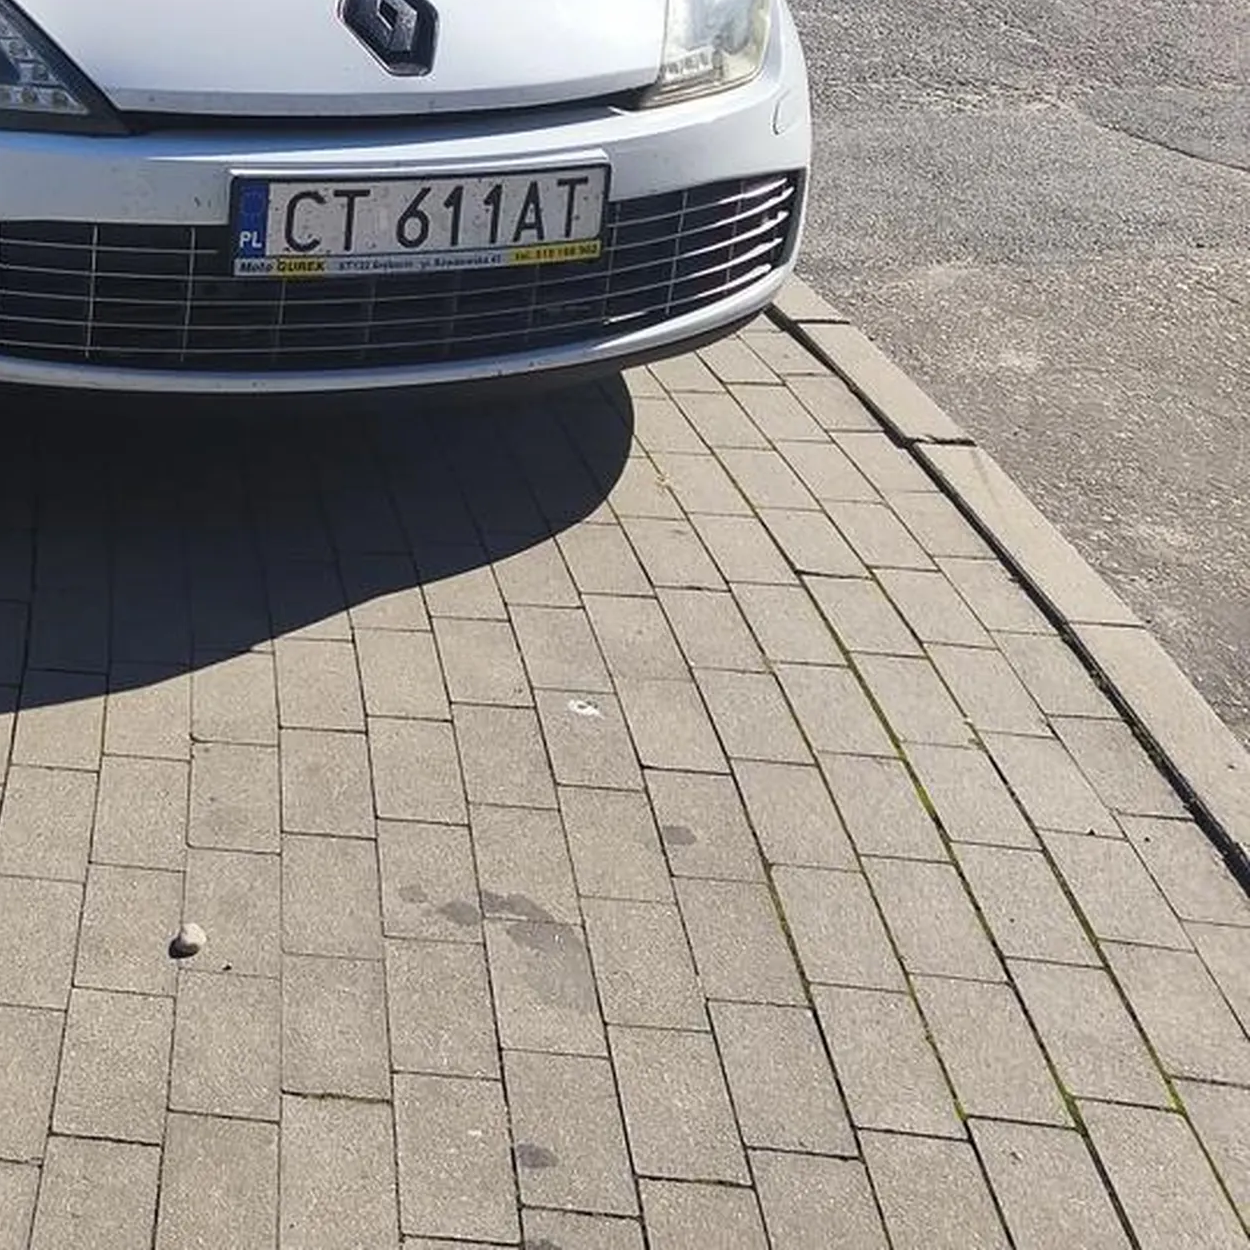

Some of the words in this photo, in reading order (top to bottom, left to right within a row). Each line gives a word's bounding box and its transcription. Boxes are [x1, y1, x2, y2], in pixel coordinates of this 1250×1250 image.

[285, 189, 371, 252] CT
[395, 177, 590, 249] 611AT
[239, 231, 263, 248] PL
